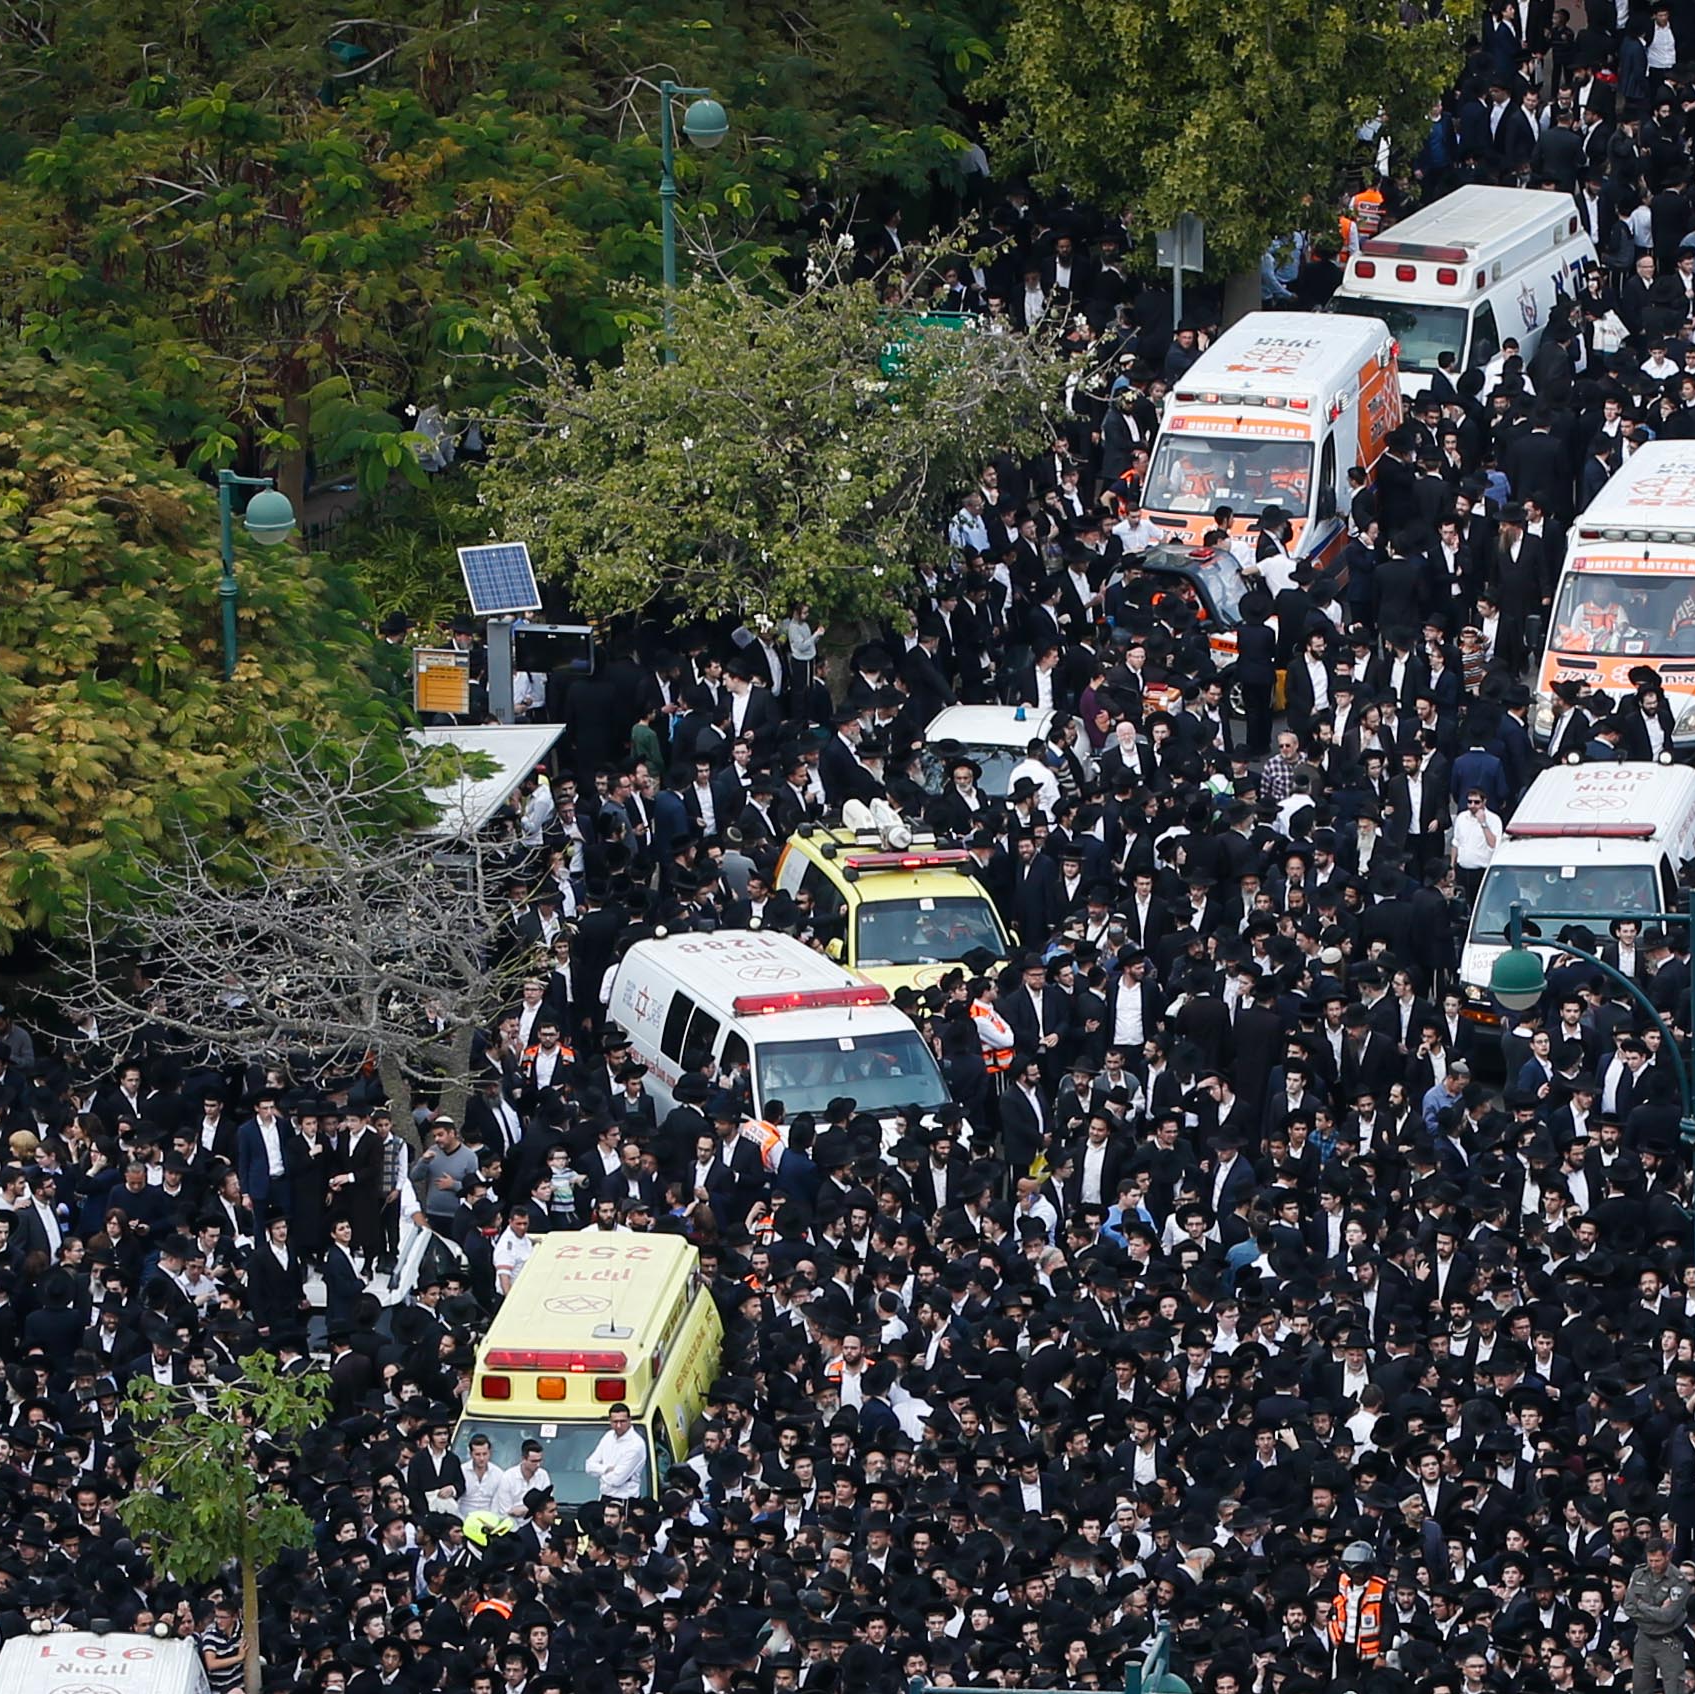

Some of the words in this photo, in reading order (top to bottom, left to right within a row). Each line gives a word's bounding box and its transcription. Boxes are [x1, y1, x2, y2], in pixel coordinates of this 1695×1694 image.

[1187, 421, 1234, 432] UNITED
[1238, 424, 1306, 438] HATZALAH
[1585, 560, 1634, 570] UNITED
[555, 1244, 654, 1261] 252
